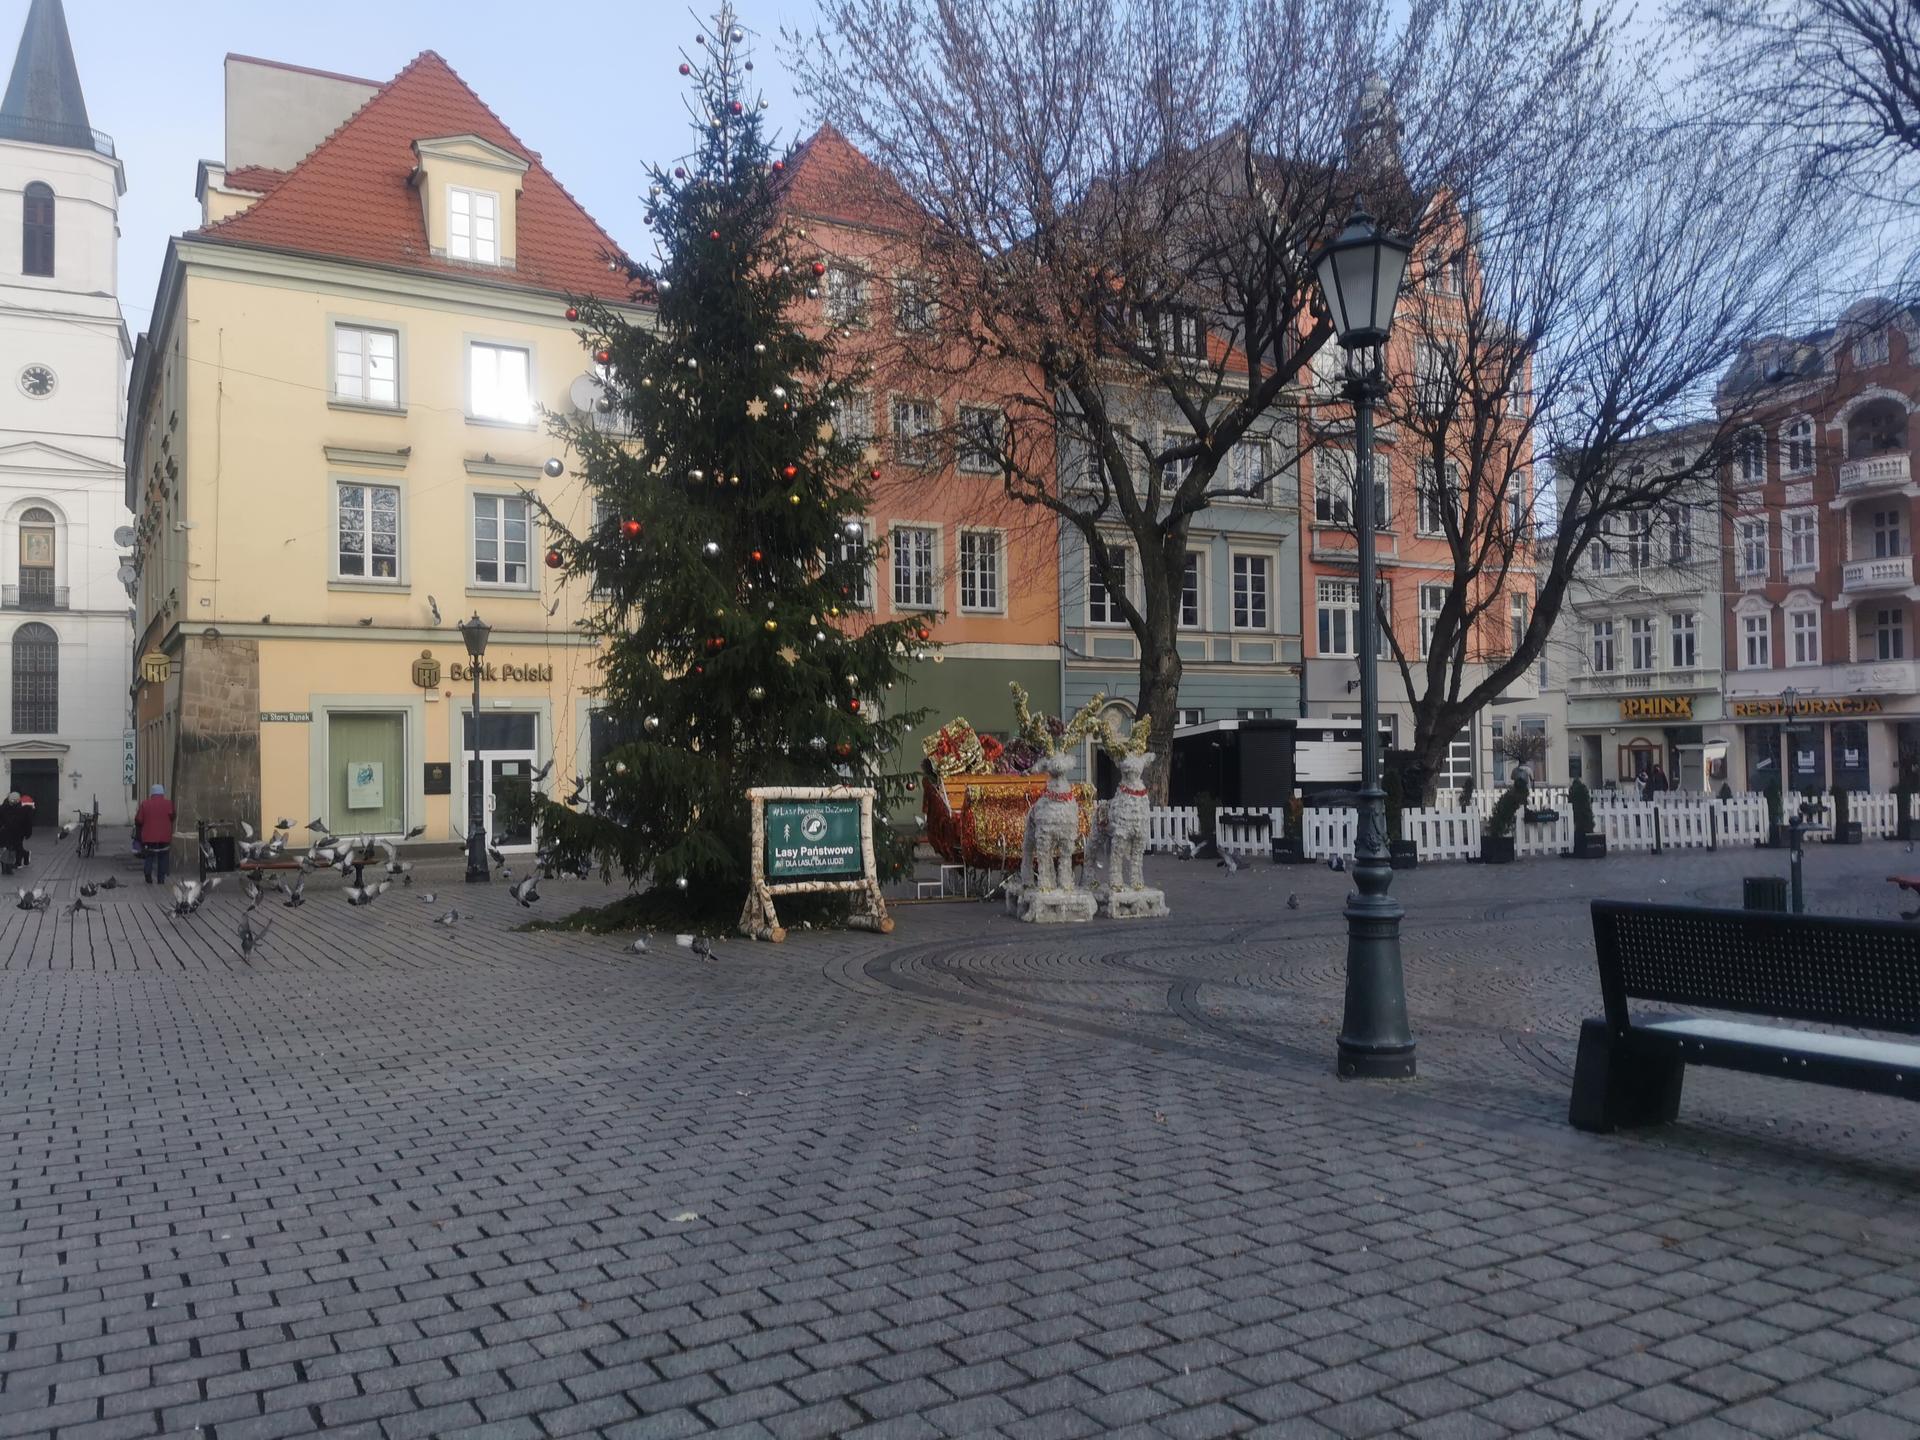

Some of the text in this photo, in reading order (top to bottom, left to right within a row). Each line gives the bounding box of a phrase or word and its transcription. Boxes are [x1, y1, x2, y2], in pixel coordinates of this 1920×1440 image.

[502, 662, 553, 681] Polski
[1619, 696, 1691, 719] SPHINX
[1734, 698, 1882, 716] RESTURACJA
[289, 712, 310, 722] Rynek
[125, 741, 135, 784] BANK
[775, 847, 798, 859] Lasy
[800, 844, 854, 856] Państwowe
[785, 860, 798, 868] DLA
